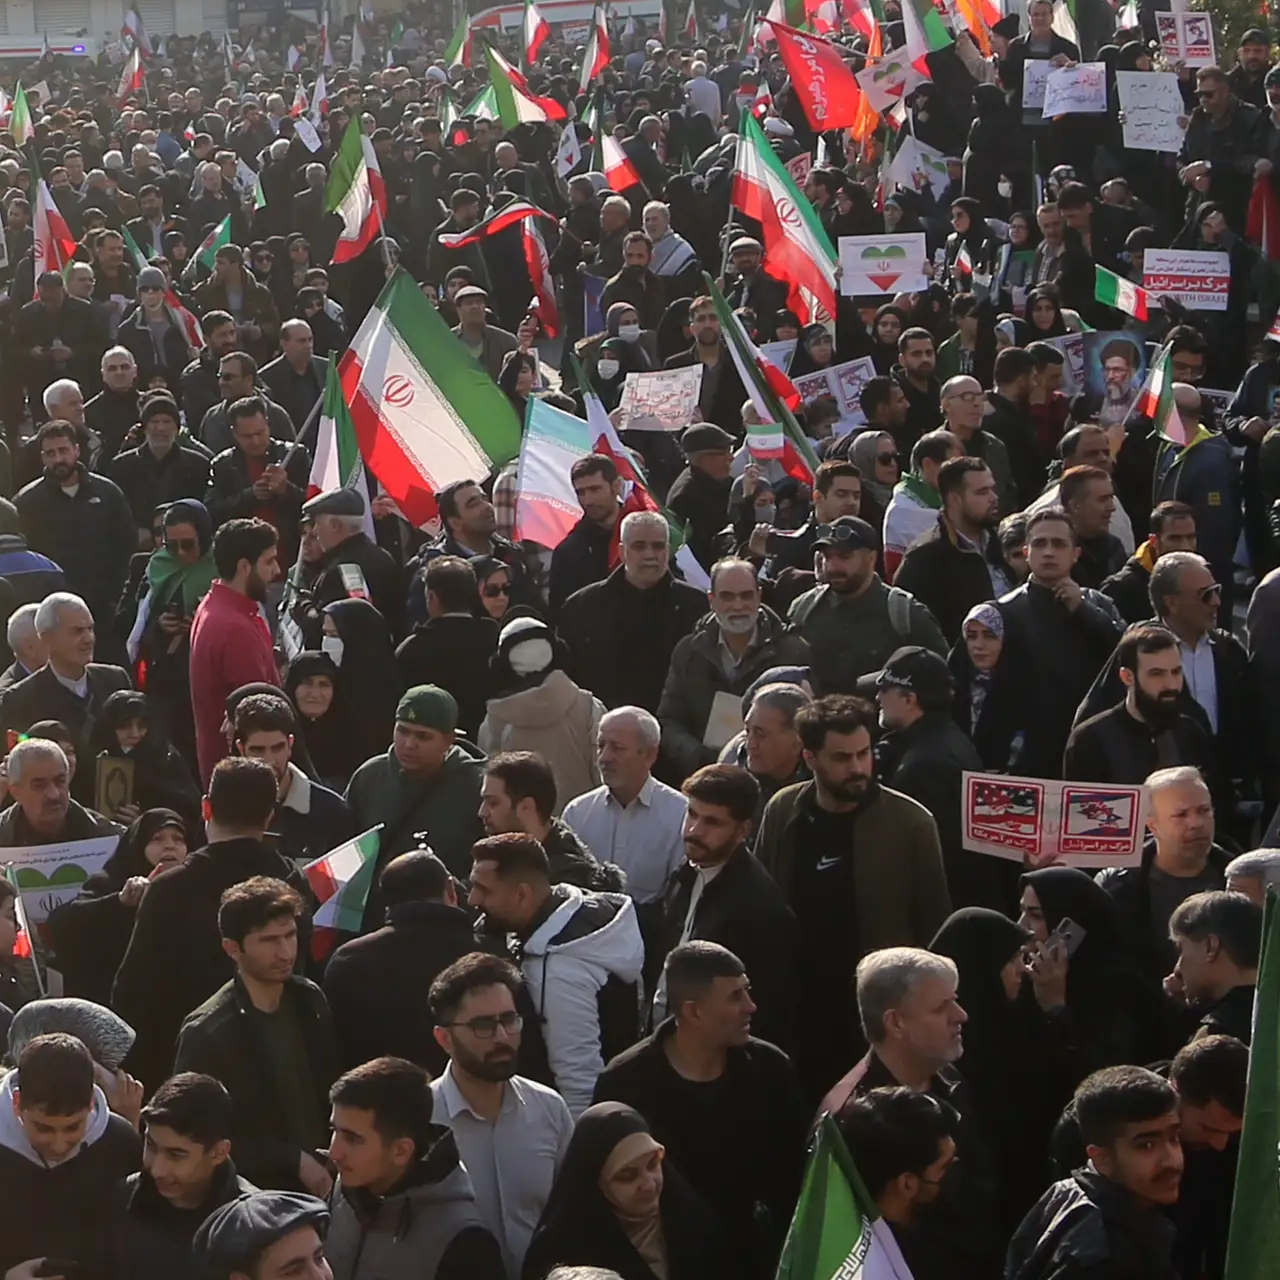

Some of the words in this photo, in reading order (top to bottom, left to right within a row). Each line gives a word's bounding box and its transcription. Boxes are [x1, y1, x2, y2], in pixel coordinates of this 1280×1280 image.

[1143, 276, 1187, 290] اسرائیل
[1201, 276, 1228, 291] مرگ
[1197, 293, 1227, 303] ISRAEL
[1063, 839, 1098, 851] اسرائیل
[1110, 843, 1131, 852] مرگ
